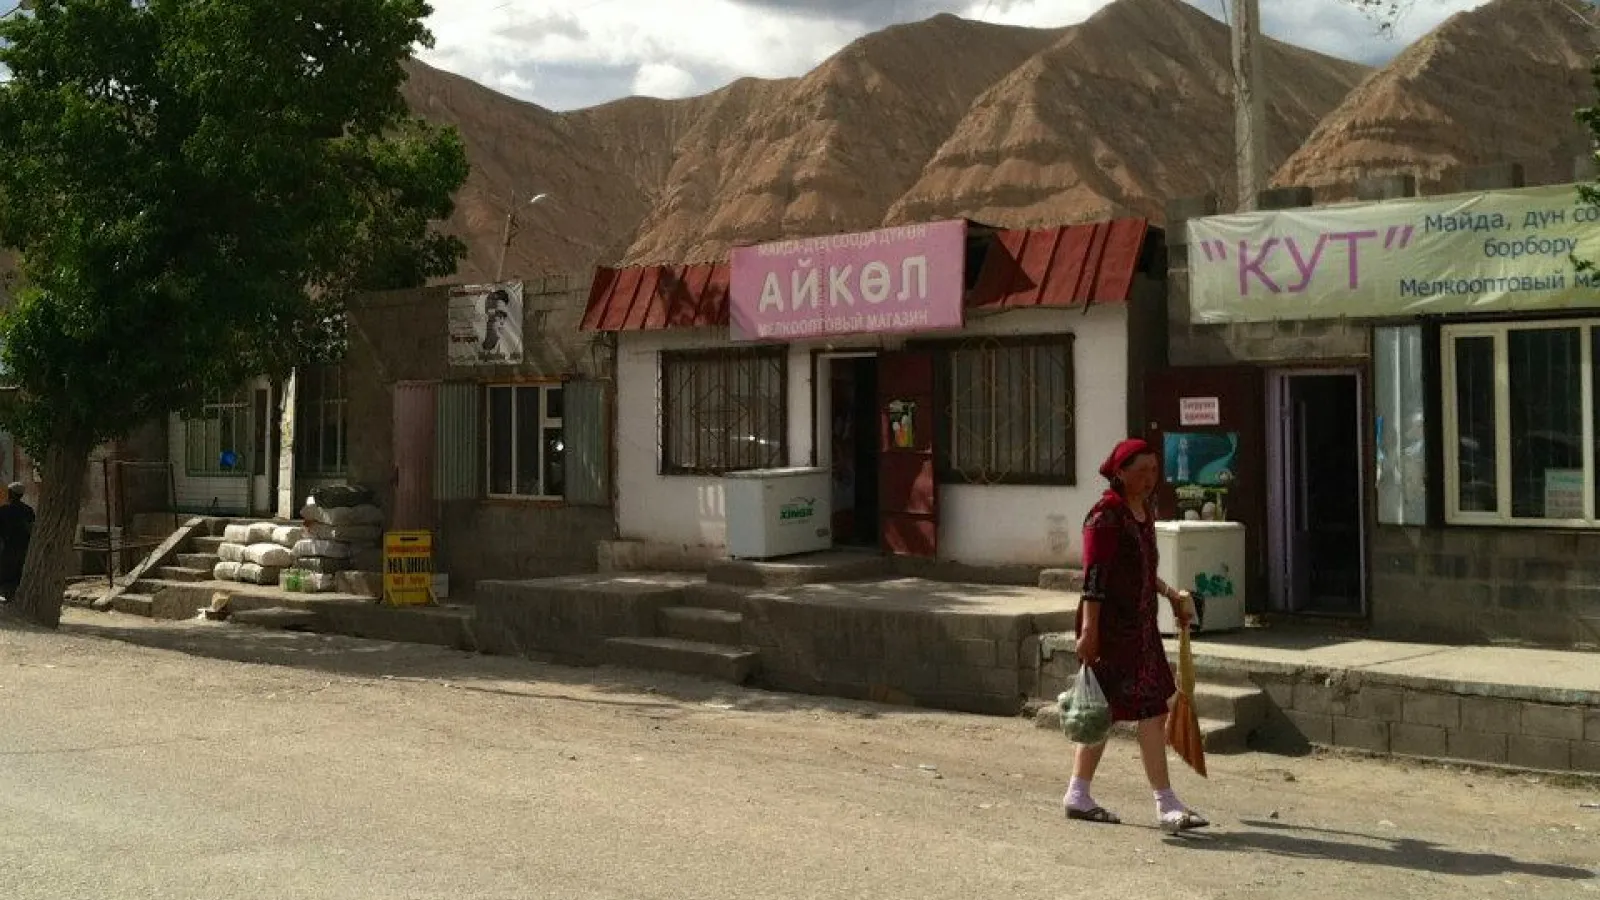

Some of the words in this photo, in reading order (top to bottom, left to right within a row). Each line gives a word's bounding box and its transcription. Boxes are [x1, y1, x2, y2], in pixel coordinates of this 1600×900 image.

[1425, 211, 1511, 233] Майда,
[759, 255, 927, 313] АЙКӨЛ
[1400, 270, 1564, 297] Мелкооптовый
[866, 309, 927, 333] МАГАЗИН
